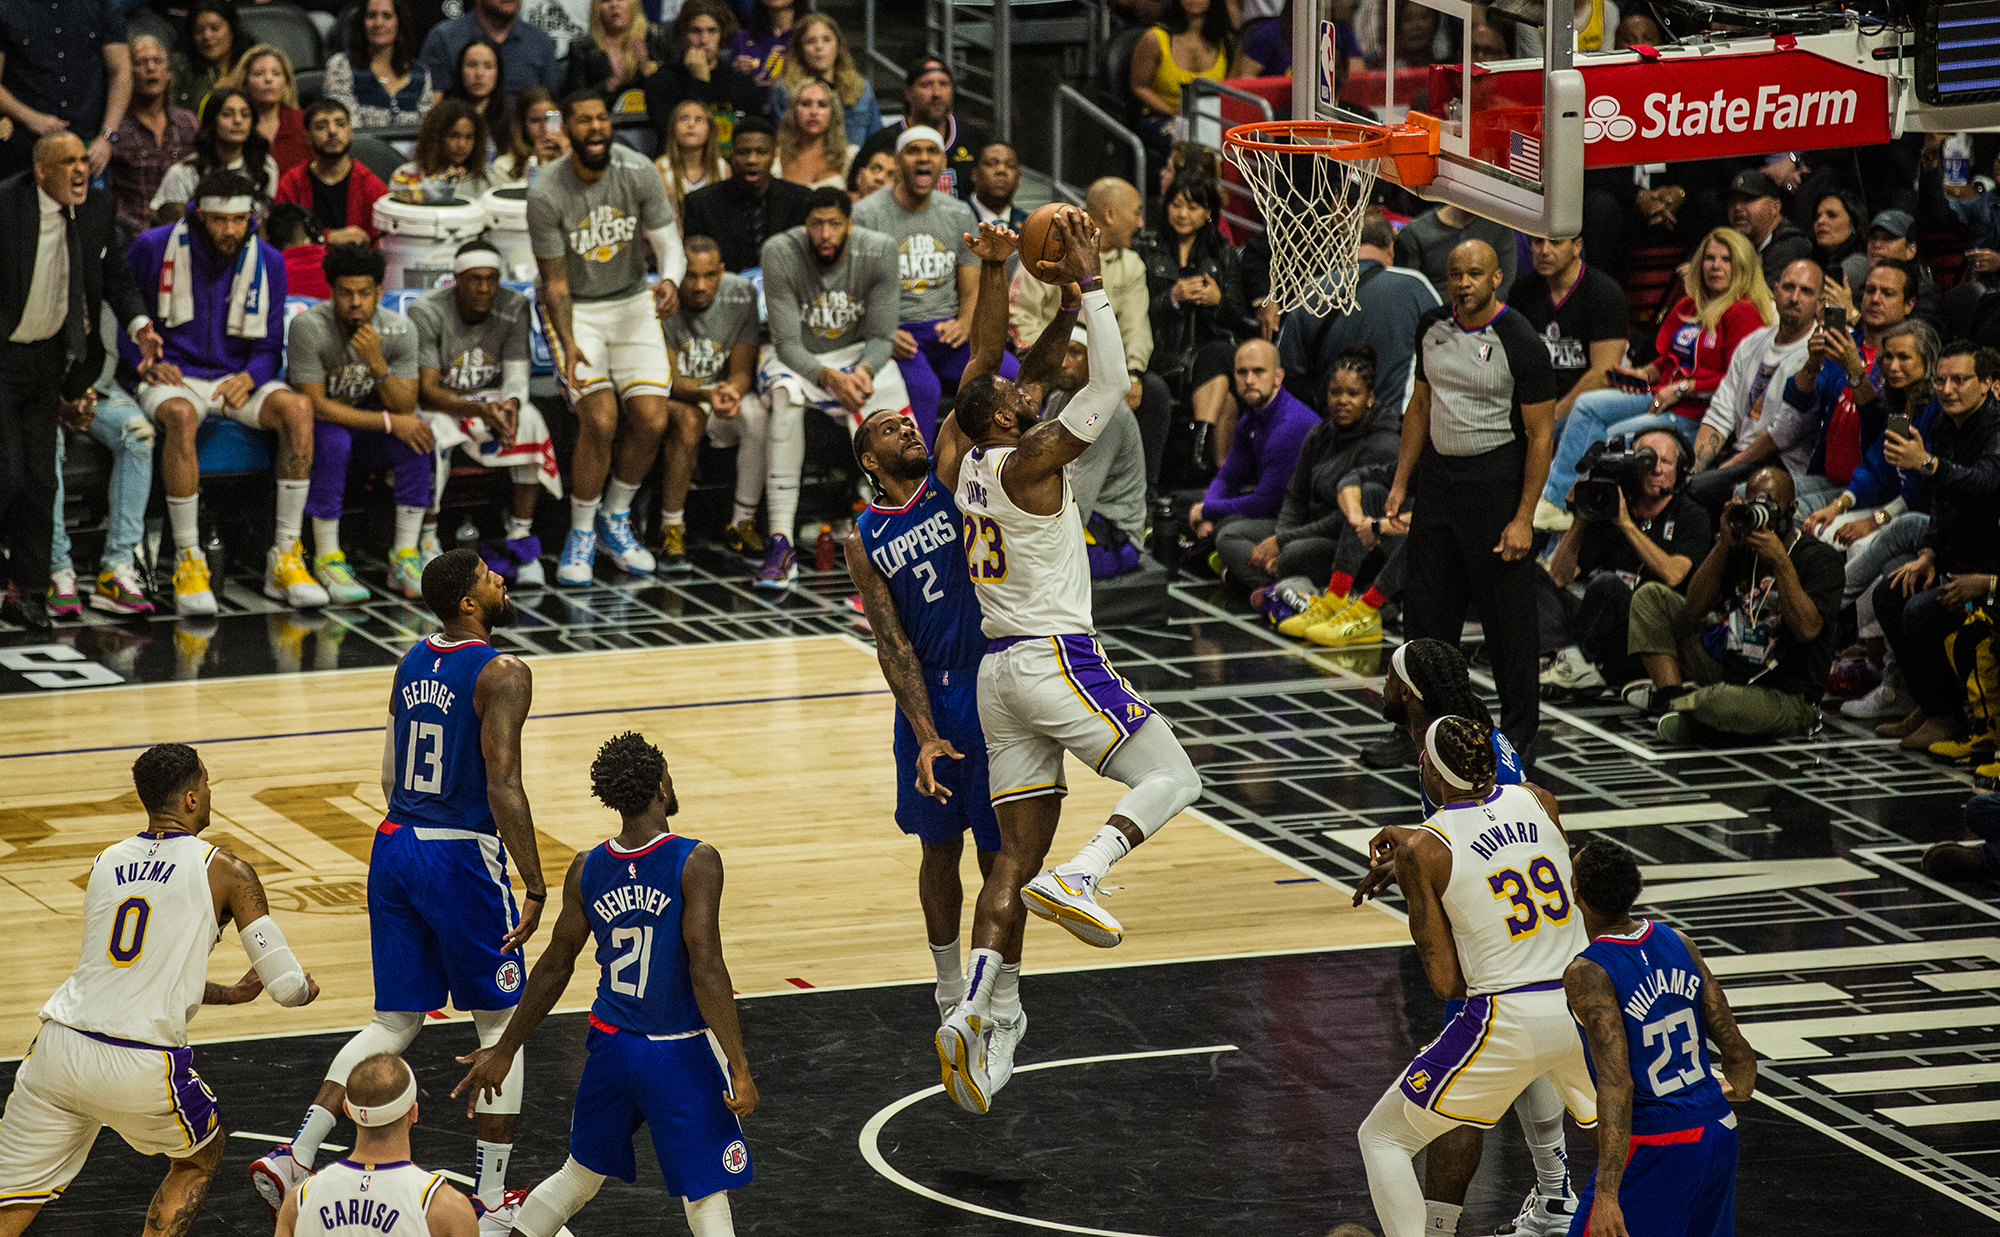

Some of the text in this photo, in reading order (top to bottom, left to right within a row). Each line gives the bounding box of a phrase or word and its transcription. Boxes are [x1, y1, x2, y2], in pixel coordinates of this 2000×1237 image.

[908, 233, 935, 252] LOS
[899, 251, 956, 280] AKERS
[966, 480, 988, 509] JAMES
[871, 510, 957, 579] CLIPPERS
[963, 512, 1010, 584] 23
[911, 560, 945, 603] 2
[402, 679, 456, 715] GEORGE
[404, 720, 444, 795] 13
[1470, 821, 1538, 861] HOWARD
[114, 860, 177, 886] KUZMA
[1485, 854, 1573, 944] 39
[106, 895, 153, 969] 0
[610, 925, 654, 999] 21
[1642, 1007, 1706, 1098] 23
[320, 1198, 400, 1235] CARUSO
